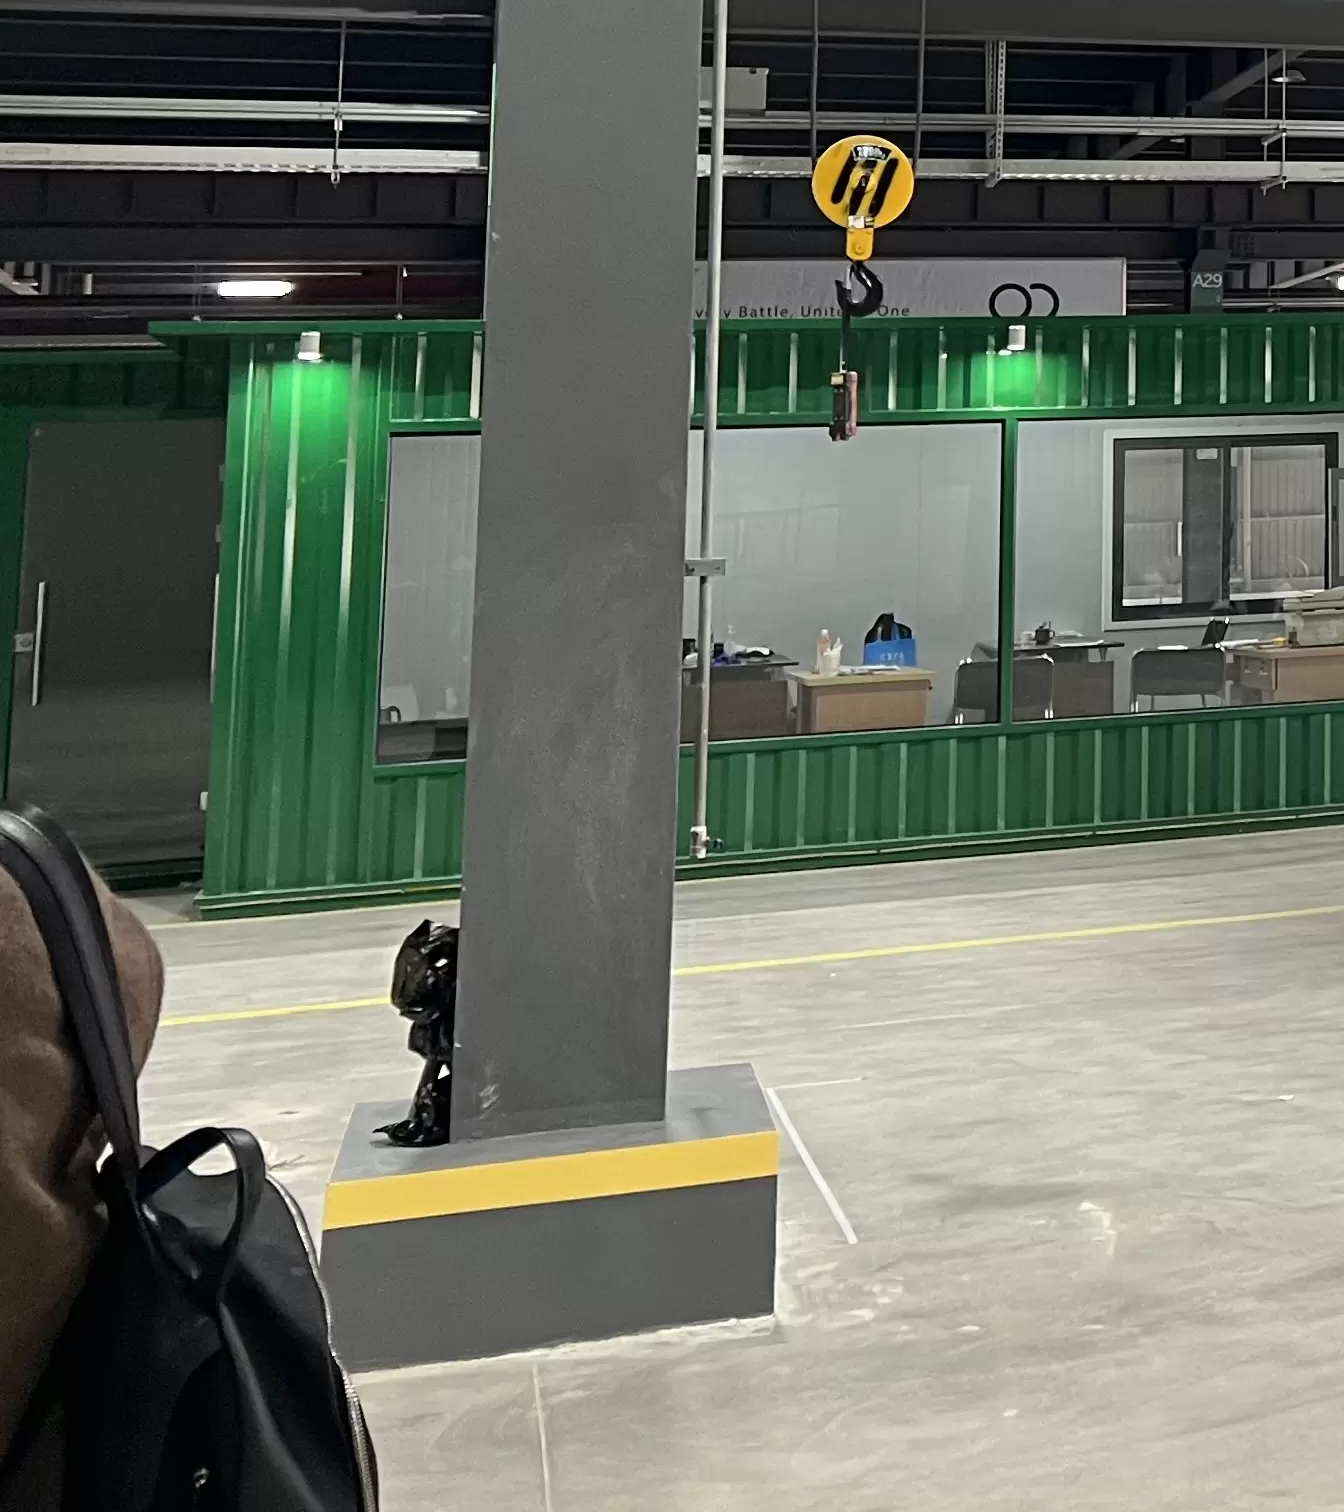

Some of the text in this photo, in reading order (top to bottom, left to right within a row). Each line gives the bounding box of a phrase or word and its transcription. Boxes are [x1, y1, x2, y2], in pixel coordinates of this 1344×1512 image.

[1192, 273, 1223, 288] A29
[738, 305, 793, 319] Battle,
[878, 304, 910, 317] One
